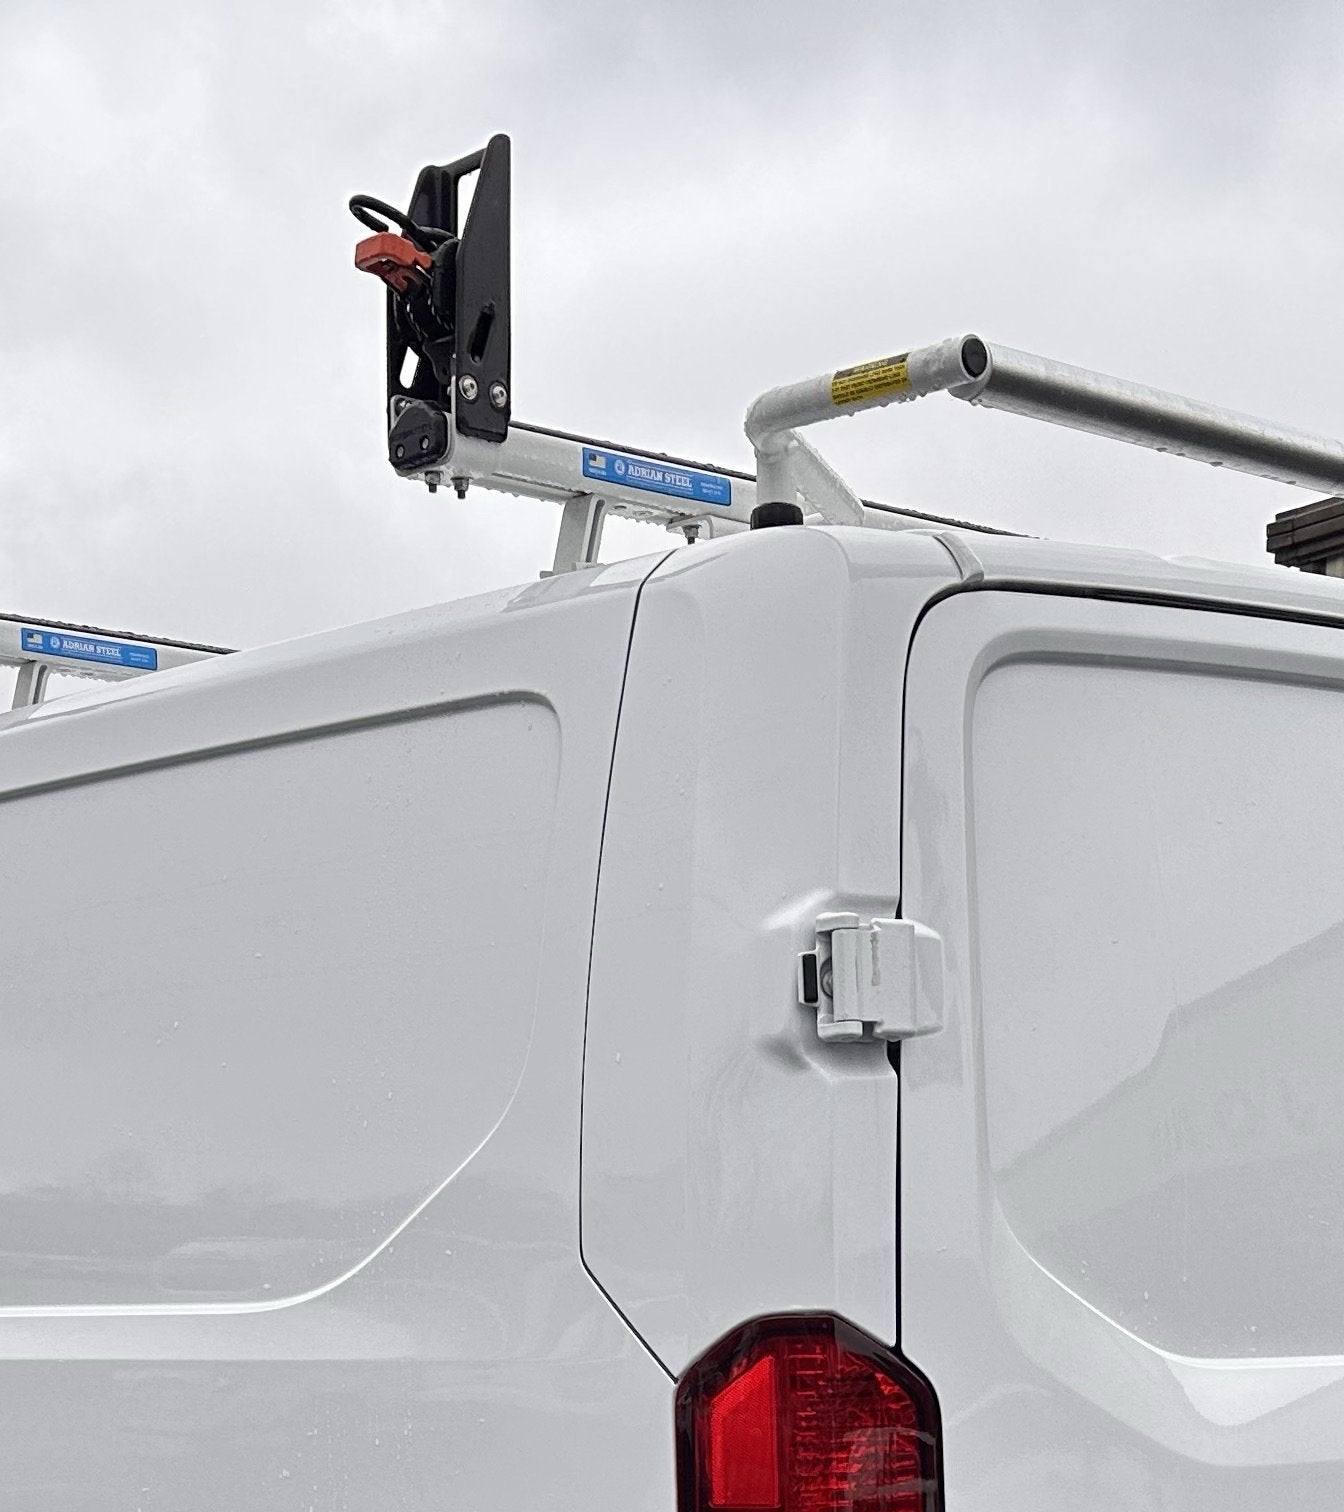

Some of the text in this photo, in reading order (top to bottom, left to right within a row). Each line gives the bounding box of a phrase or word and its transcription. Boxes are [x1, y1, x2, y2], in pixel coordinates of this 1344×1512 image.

[627, 464, 663, 482] ADRIAN
[664, 473, 692, 488] STEEL
[62, 639, 121, 657] ADRIAN STEEL
